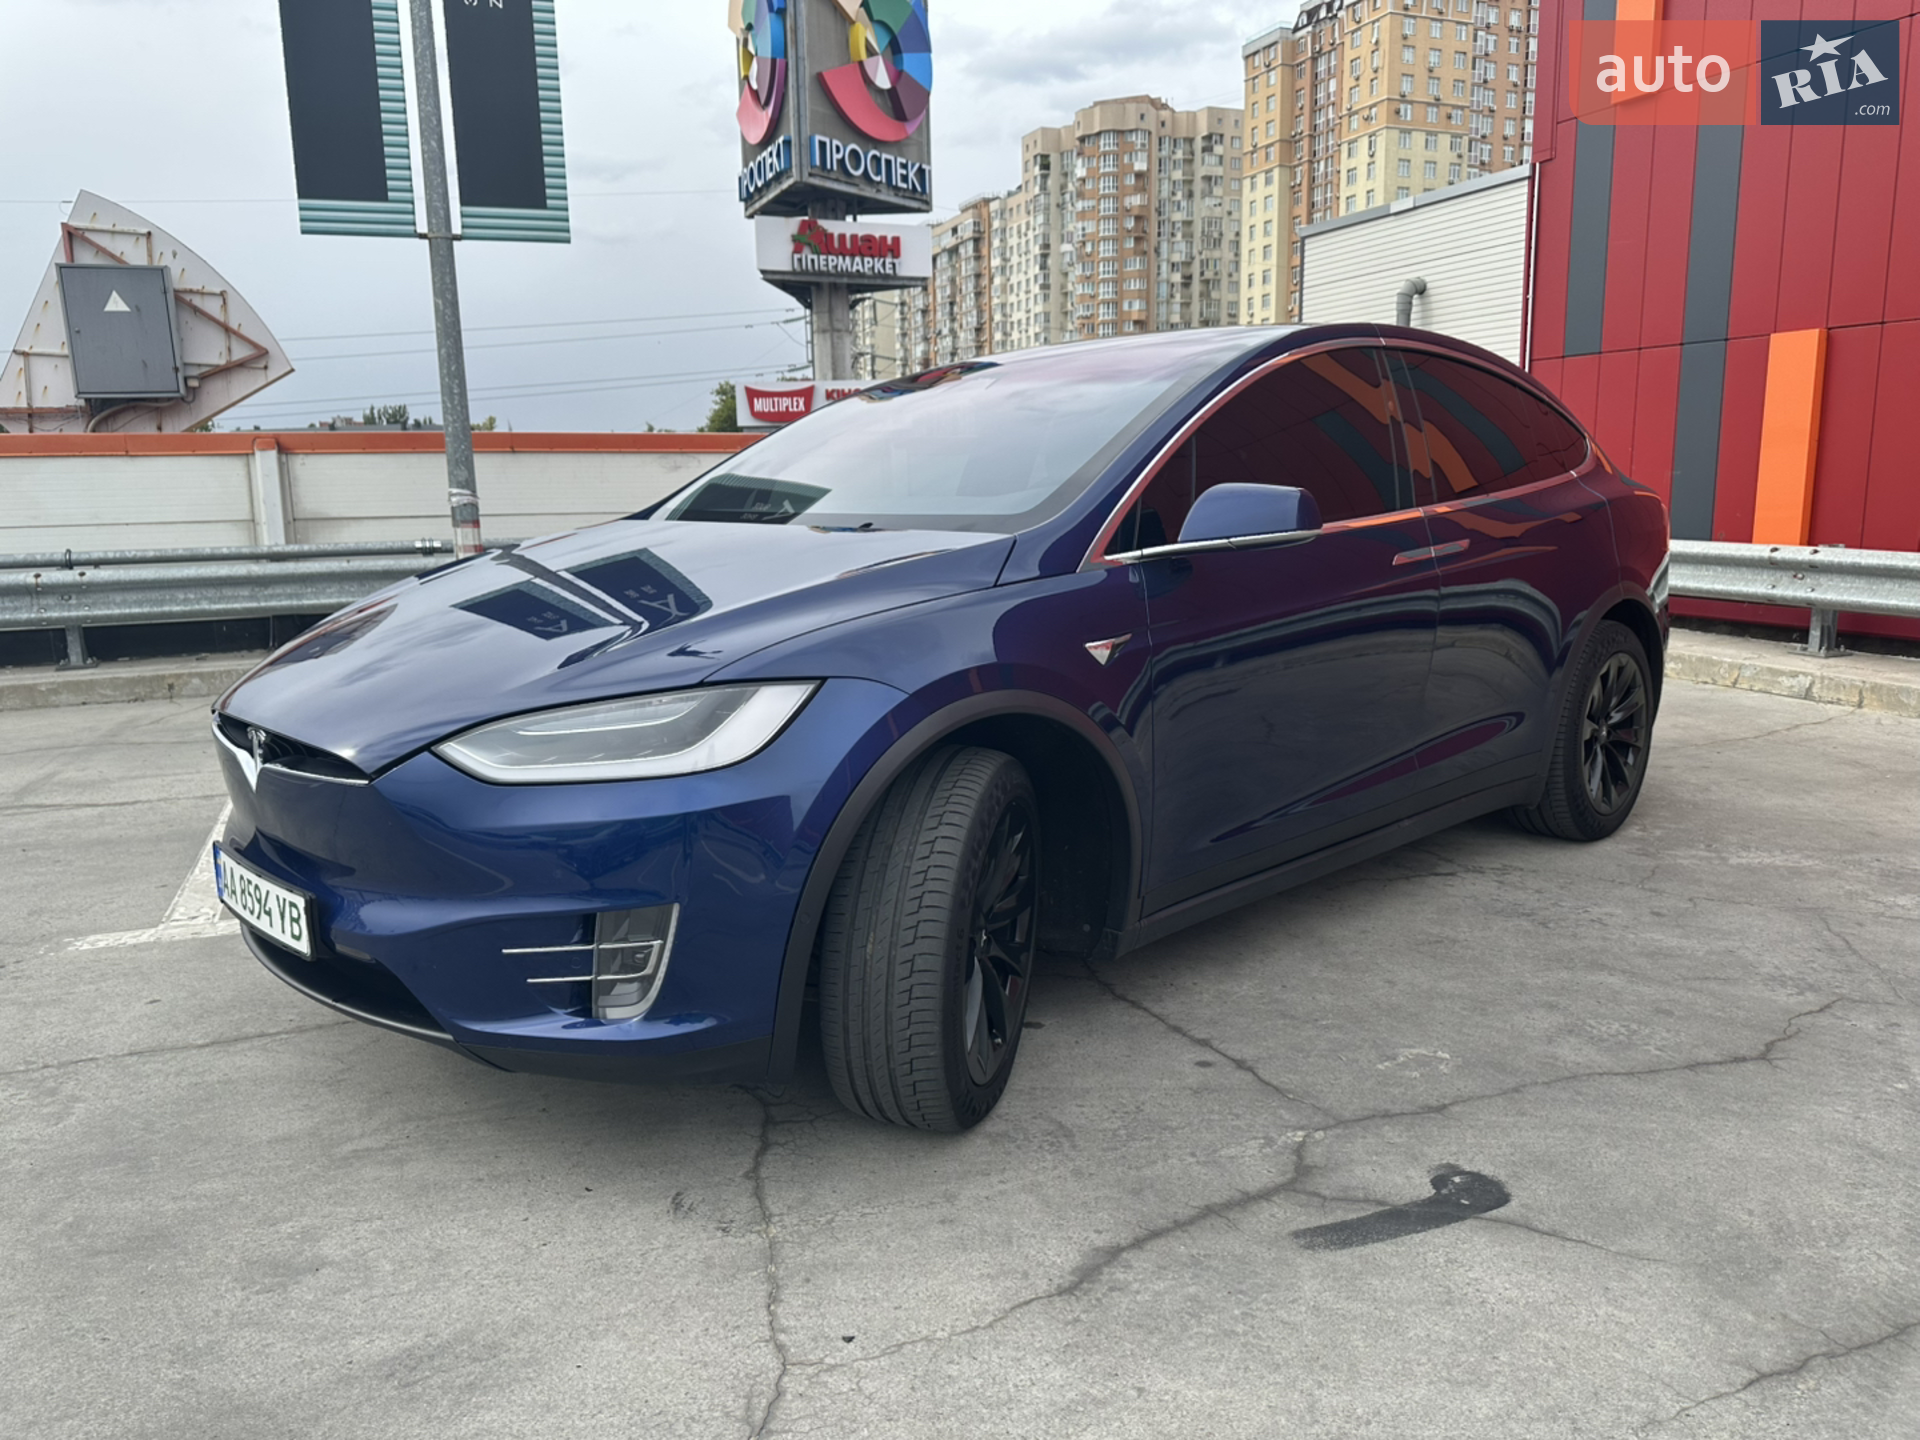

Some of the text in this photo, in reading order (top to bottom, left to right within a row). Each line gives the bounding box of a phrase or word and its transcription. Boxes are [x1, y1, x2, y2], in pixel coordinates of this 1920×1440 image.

[812, 134, 932, 195] ПРОСПЕКТ
[793, 254, 900, 274] ГІПЕРМАРКЕТ
[753, 396, 805, 412] MULTIPLEX
[224, 861, 303, 942] AA 8594 YB
